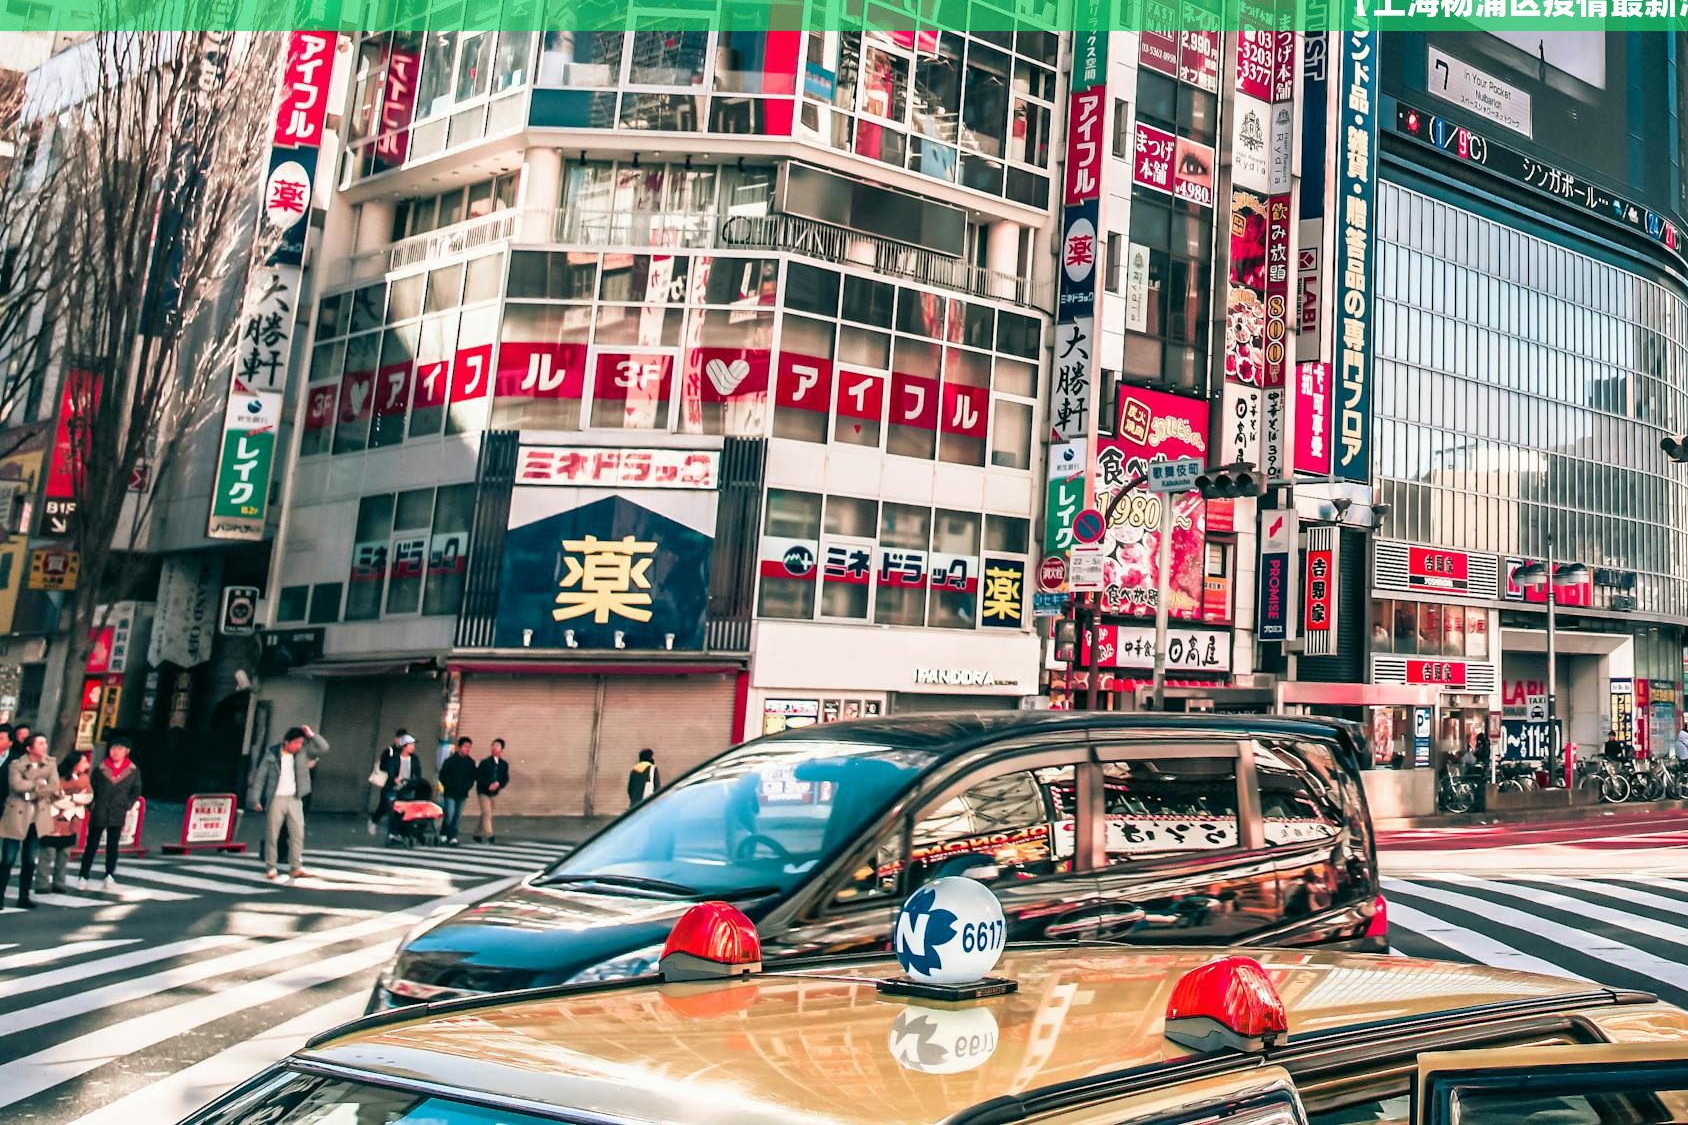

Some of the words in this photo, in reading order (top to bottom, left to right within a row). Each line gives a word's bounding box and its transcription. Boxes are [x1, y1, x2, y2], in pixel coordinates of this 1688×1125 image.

[1147, 18, 1173, 40] NAIL
[1148, 1, 1174, 22] FAST
[286, 34, 327, 138] アイフル
[1435, 58, 1449, 91] 7
[1073, 94, 1099, 195] アイフル
[1136, 129, 1174, 162] まつげ
[1139, 159, 1168, 186] 本舗
[268, 179, 306, 213] 薬
[1065, 235, 1094, 266] 薬
[1269, 202, 1288, 283] 飲み放題
[1302, 276, 1317, 332] LABI
[1266, 294, 1286, 360] 800
[386, 353, 566, 410] アイフル
[614, 361, 662, 389] 3F
[791, 364, 979, 429] アイフル
[1055, 325, 1090, 433] 大勝軒
[228, 437, 260, 504] レイク
[522, 451, 711, 486] ミネドラッグ
[1152, 462, 1199, 480] 歌舞伎町
[1055, 483, 1077, 549] レイク
[552, 534, 658, 624] 薬
[823, 546, 969, 590] ミネドラッグ
[1424, 554, 1454, 574] 吉野家
[984, 566, 1023, 620] 薬
[1267, 559, 1281, 620] PROMISE
[1311, 557, 1327, 624] 吉野家
[1168, 634, 1220, 667] 日高屋
[1528, 696, 1547, 704] TAXI
[962, 919, 1003, 954] 6617
